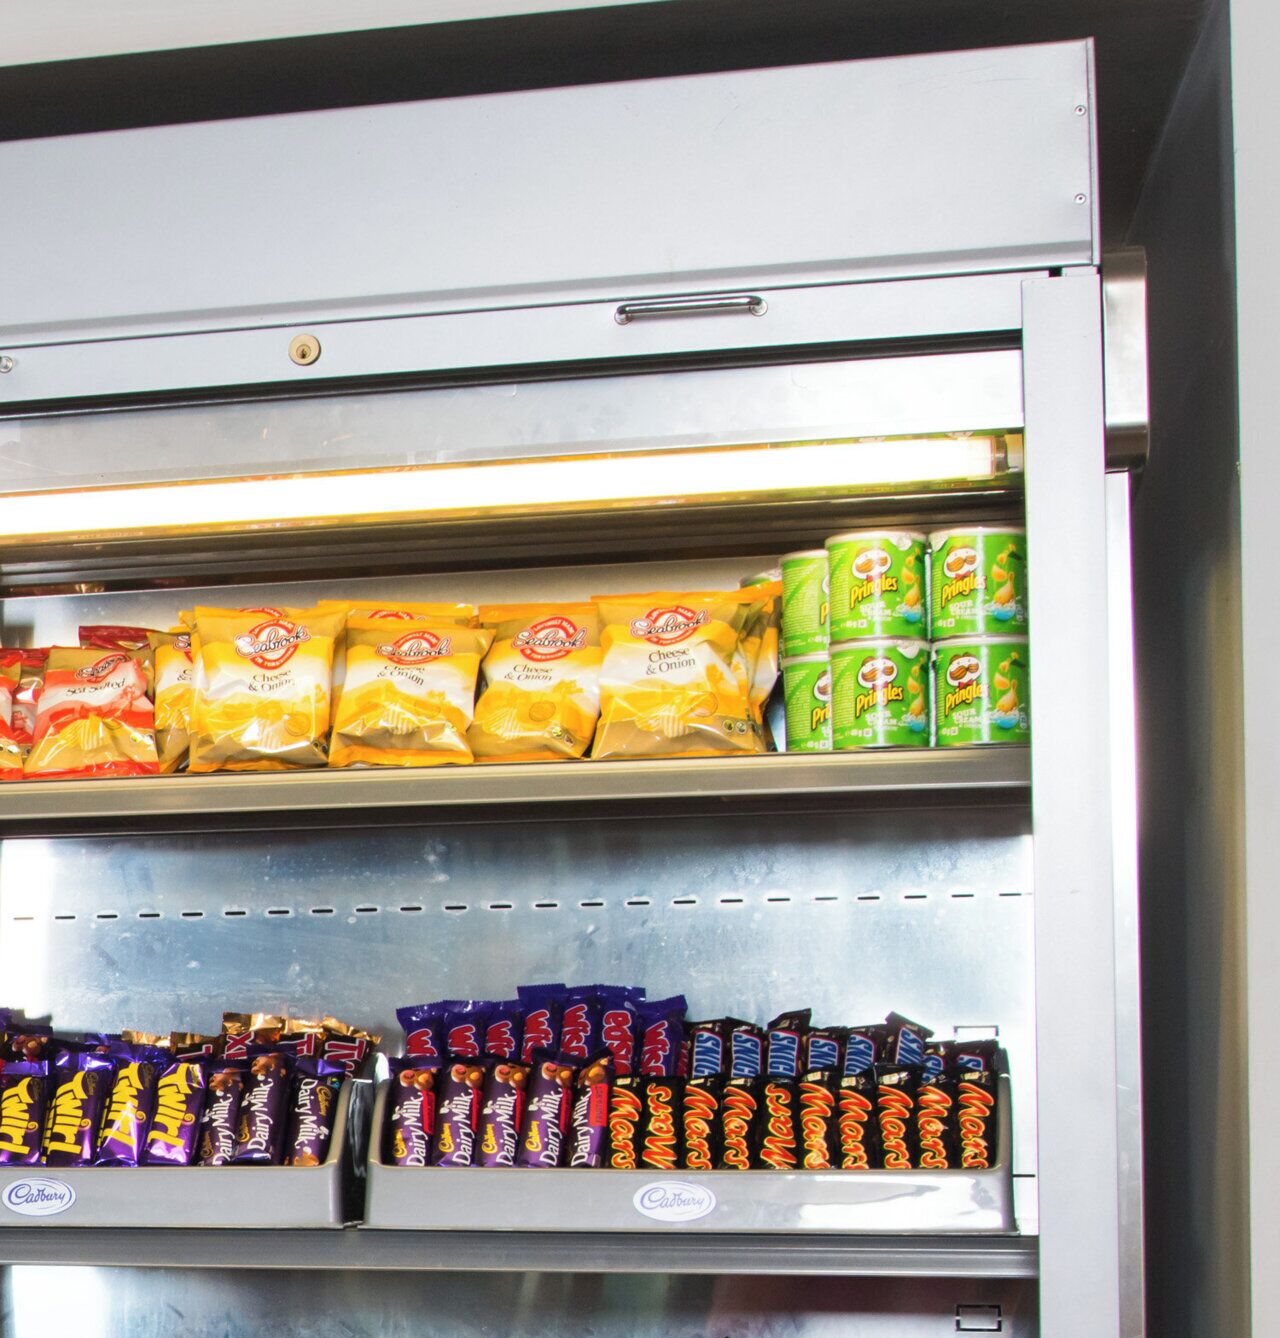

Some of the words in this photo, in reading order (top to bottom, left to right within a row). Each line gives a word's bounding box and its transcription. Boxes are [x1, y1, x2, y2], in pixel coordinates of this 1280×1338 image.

[235, 624, 310, 657] Seabrook
[514, 626, 587, 648] Seabrook
[633, 610, 708, 637] Seabrook
[513, 664, 553, 674] Cheese
[646, 664, 656, 676] &
[658, 658, 696, 674] Onion
[648, 648, 690, 663] Cheese
[248, 684, 258, 692] &
[261, 680, 295, 692] Onion
[253, 669, 292, 683] Cheese
[389, 670, 425, 687] Onion
[504, 673, 515, 681] &
[517, 672, 553, 681] Onion
[47, 1071, 88, 1155] Twirl
[147, 1062, 192, 1147] Twirl
[212, 1094, 234, 1127] Milk
[250, 1078, 274, 1111] Milk
[295, 1079, 318, 1114] Dairy
[401, 1091, 425, 1129] Milk
[451, 1089, 475, 1126] Milk
[494, 1089, 518, 1126] Milk
[538, 1087, 563, 1126] Milk
[573, 1087, 593, 1127] Milk
[247, 1112, 274, 1150] Dairy
[295, 1115, 318, 1148] Milk
[610, 1087, 642, 1169] Mars
[642, 1083, 677, 1169] Mars
[684, 1085, 718, 1170] Mars
[722, 1086, 757, 1170] Mars
[761, 1083, 798, 1170] Mars
[799, 1083, 835, 1170] Mars
[839, 1089, 872, 1170] Mars
[878, 1085, 914, 1170] Mars
[918, 1086, 952, 1170] Mars
[958, 1082, 994, 1169] Mars
[212, 1127, 236, 1165] Dairy
[406, 1129, 428, 1166] Dairy
[452, 1126, 477, 1165] Dairy
[495, 1126, 520, 1165] Dairy
[539, 1125, 563, 1165] Dairy
[571, 1126, 593, 1166] Dairy
[7, 1182, 67, 1207] Cadbury
[640, 1186, 706, 1210] Cadbury
